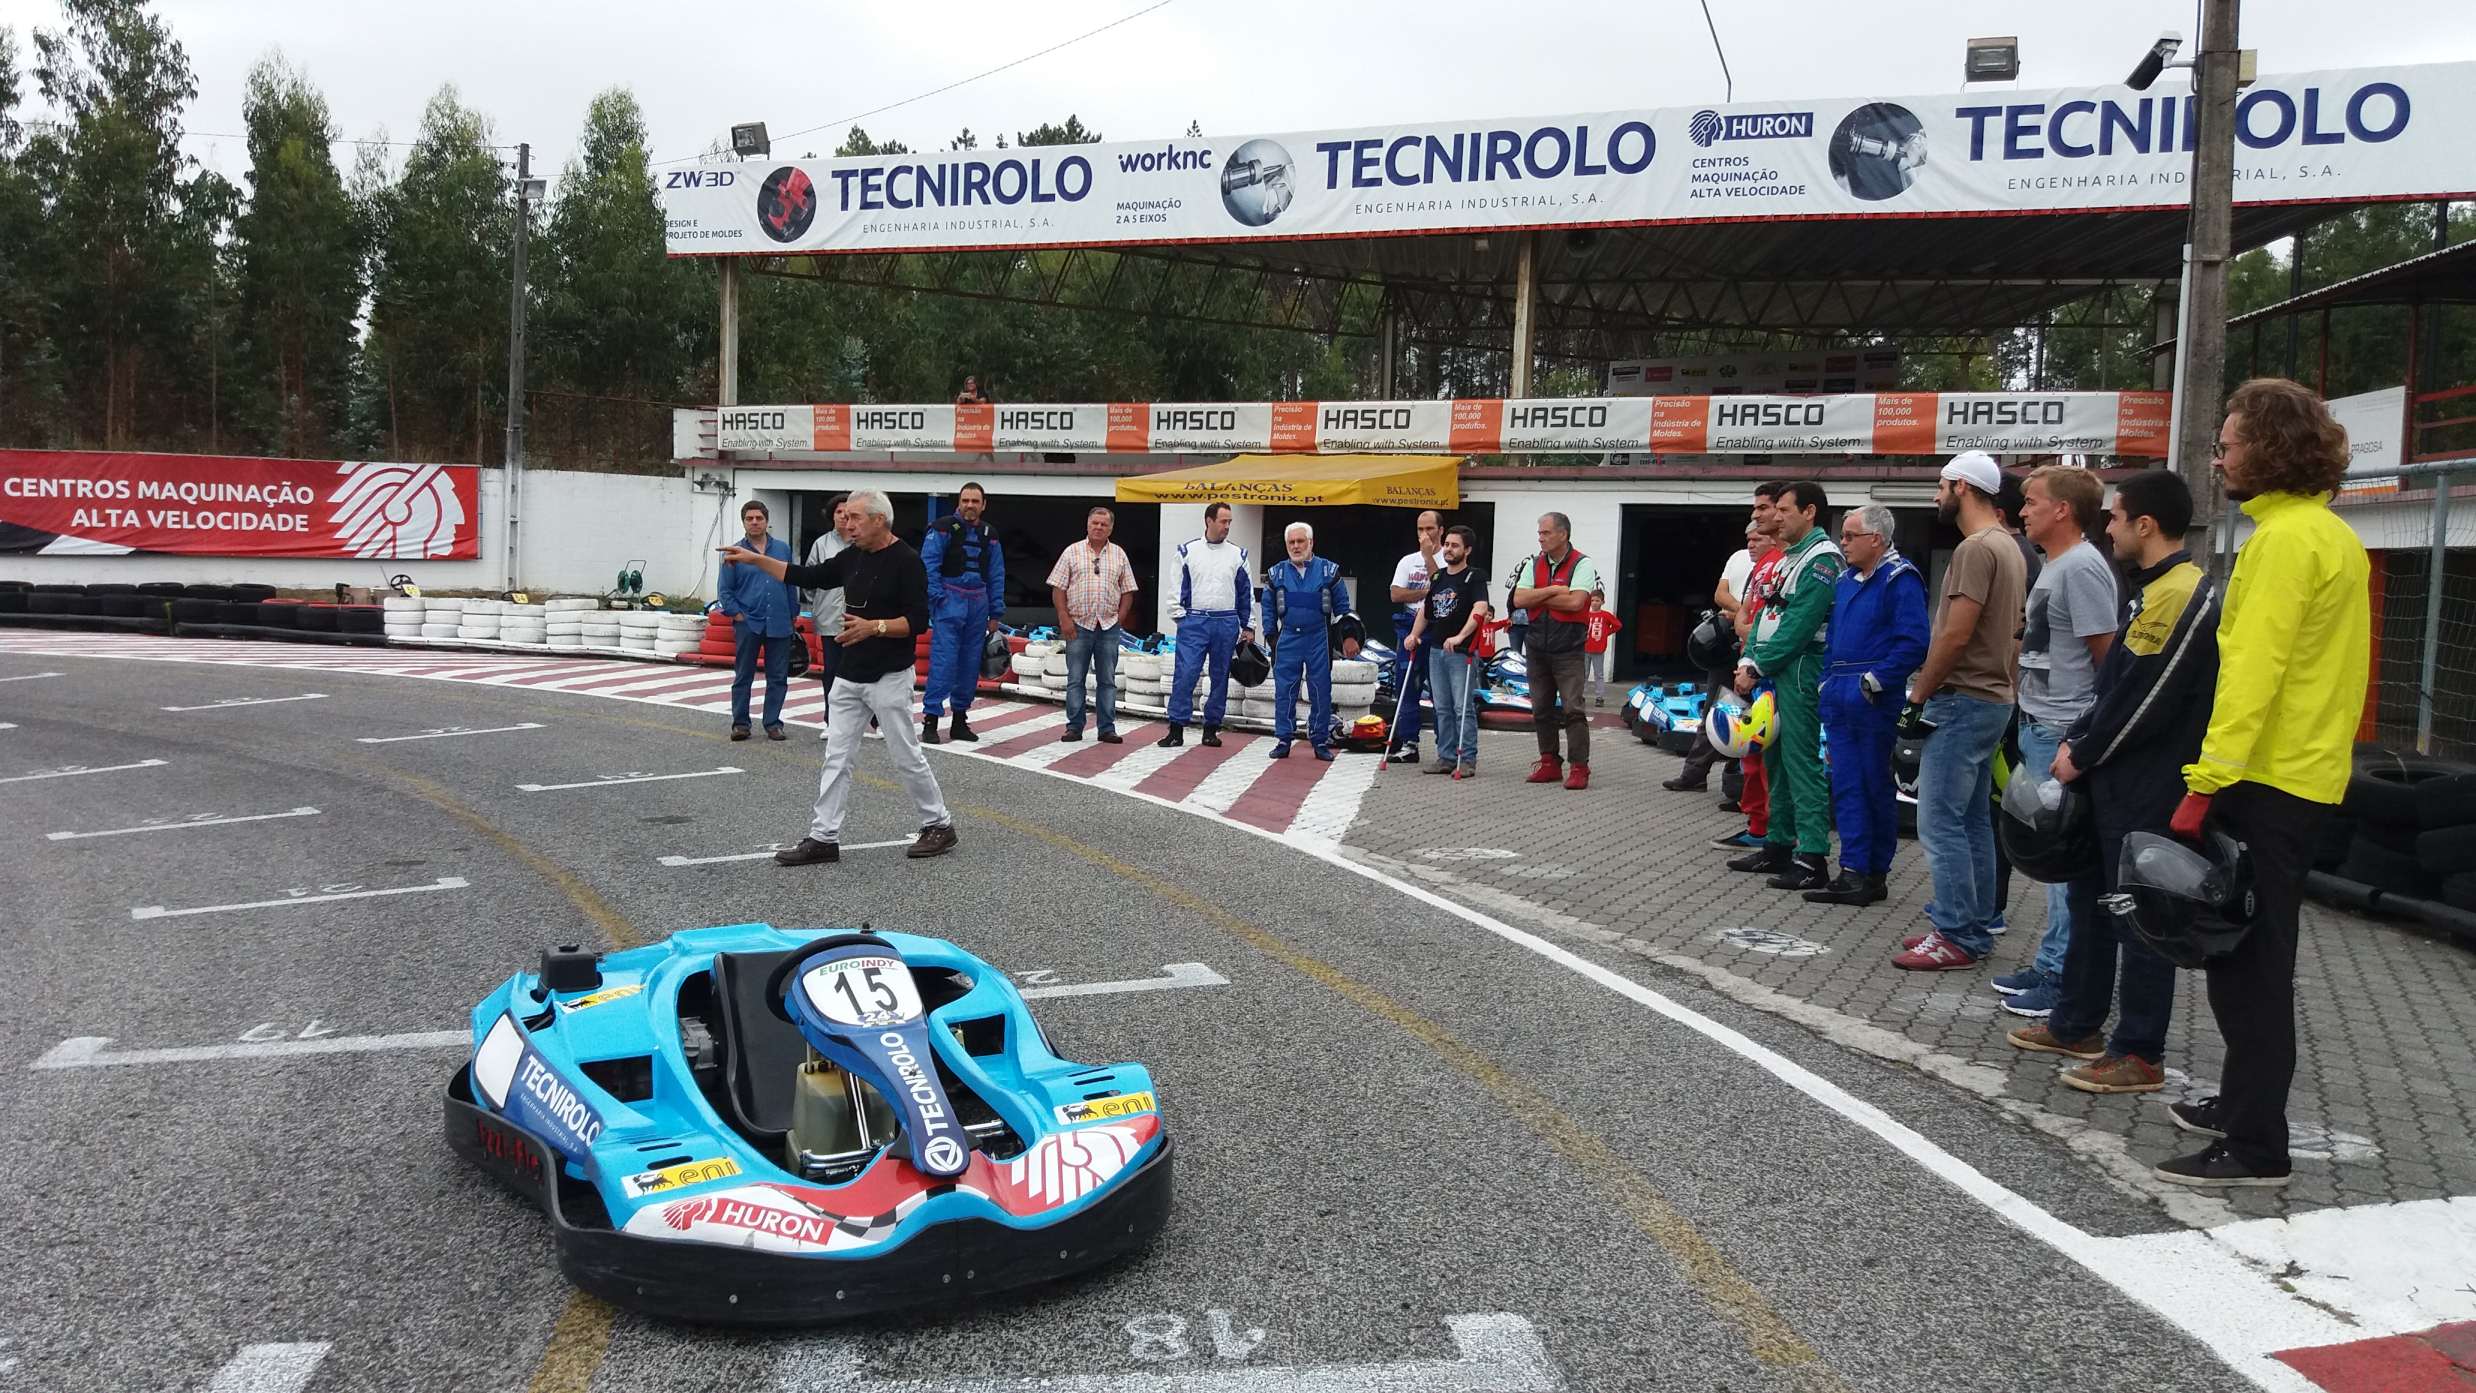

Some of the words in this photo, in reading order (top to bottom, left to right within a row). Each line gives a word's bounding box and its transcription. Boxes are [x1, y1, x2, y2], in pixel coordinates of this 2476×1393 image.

[1732, 116, 1806, 137] HURON
[1956, 82, 2411, 161] TECNIOLO
[1117, 144, 1212, 173] worknc
[1316, 121, 1656, 190] TECNIROLO
[1692, 156, 1750, 169] CENTROS
[666, 171, 735, 188] ZW3D
[832, 156, 1093, 211] TECNIROLO
[1691, 168, 1778, 183] MAQUINAÇÃO
[2007, 172, 2139, 190] ENGENHARIA
[2150, 167, 2286, 184] INDRIAL,
[2299, 165, 2342, 178] S.A.
[1690, 187, 1722, 199] ALTA
[1725, 185, 1806, 198] VELOCIDADE
[1116, 197, 1182, 211] MAQUINAÇÃO
[1355, 200, 1453, 215] ENGENHARIA
[1461, 194, 1563, 209] INDUSTRIAL,
[1572, 193, 1604, 204] S.A.
[665, 220, 691, 228] DESIGN
[863, 221, 940, 234] ENGENHARIA
[945, 218, 1024, 231] INDUSTRIAL,
[1030, 217, 1054, 227] S.A.
[1116, 215, 1122, 224] 2
[1123, 215, 1131, 223] A
[1132, 215, 1138, 223] 5
[1139, 213, 1167, 223] EIXOS
[664, 231, 699, 239] PROJETO
[699, 231, 710, 239] DE
[711, 230, 743, 238] MOLDES
[1454, 403, 1471, 411] Mais
[1472, 403, 1483, 411] de
[1654, 399, 1691, 408] Precisão
[1877, 396, 1899, 405] Mais
[1900, 396, 1913, 405] de
[2122, 395, 2165, 405] Precisão
[722, 412, 785, 431] HASCO
[856, 411, 925, 430] HASCO
[1000, 411, 1074, 430] HASCO
[1156, 411, 1236, 430] HASCO
[1323, 408, 1411, 430] HASCO
[1510, 406, 1608, 428] HASCO
[1717, 403, 1825, 426] HASCO
[1947, 401, 2065, 425] HASCO
[2120, 416, 2165, 427] Indústria
[1653, 418, 1690, 428] Indústria
[1690, 418, 1702, 427] de
[1876, 417, 1920, 427] produtos.
[1652, 428, 1684, 438] Moldes.
[757, 438, 774, 448] with
[892, 438, 911, 447] with
[1039, 438, 1060, 448] with
[1200, 438, 1221, 448] with
[1323, 438, 1371, 449] Enabling
[1373, 438, 1396, 448] with
[1509, 437, 1561, 449] Enabling
[1564, 437, 1589, 448] with
[1716, 436, 1774, 450] Enabling
[1778, 435, 1805, 448] with
[1808, 435, 1865, 449] System.
[1946, 435, 2009, 450] Enabling
[2013, 435, 2043, 448] with
[3, 477, 131, 500] CENTROS
[138, 480, 315, 506] MAQUINAÇÃO
[1154, 492, 1326, 503] www.pestronix.pt
[71, 508, 142, 528] ALTA
[147, 510, 310, 532] VELOCIDADE
[819, 959, 895, 976] EUROINDY
[834, 967, 898, 1016] 15
[880, 1032, 949, 1136] TECNIROLO
[521, 1055, 600, 1147] TECNIROLO
[1102, 1095, 1153, 1118] eni
[679, 1160, 737, 1185] eni
[721, 1202, 825, 1241] HURON
